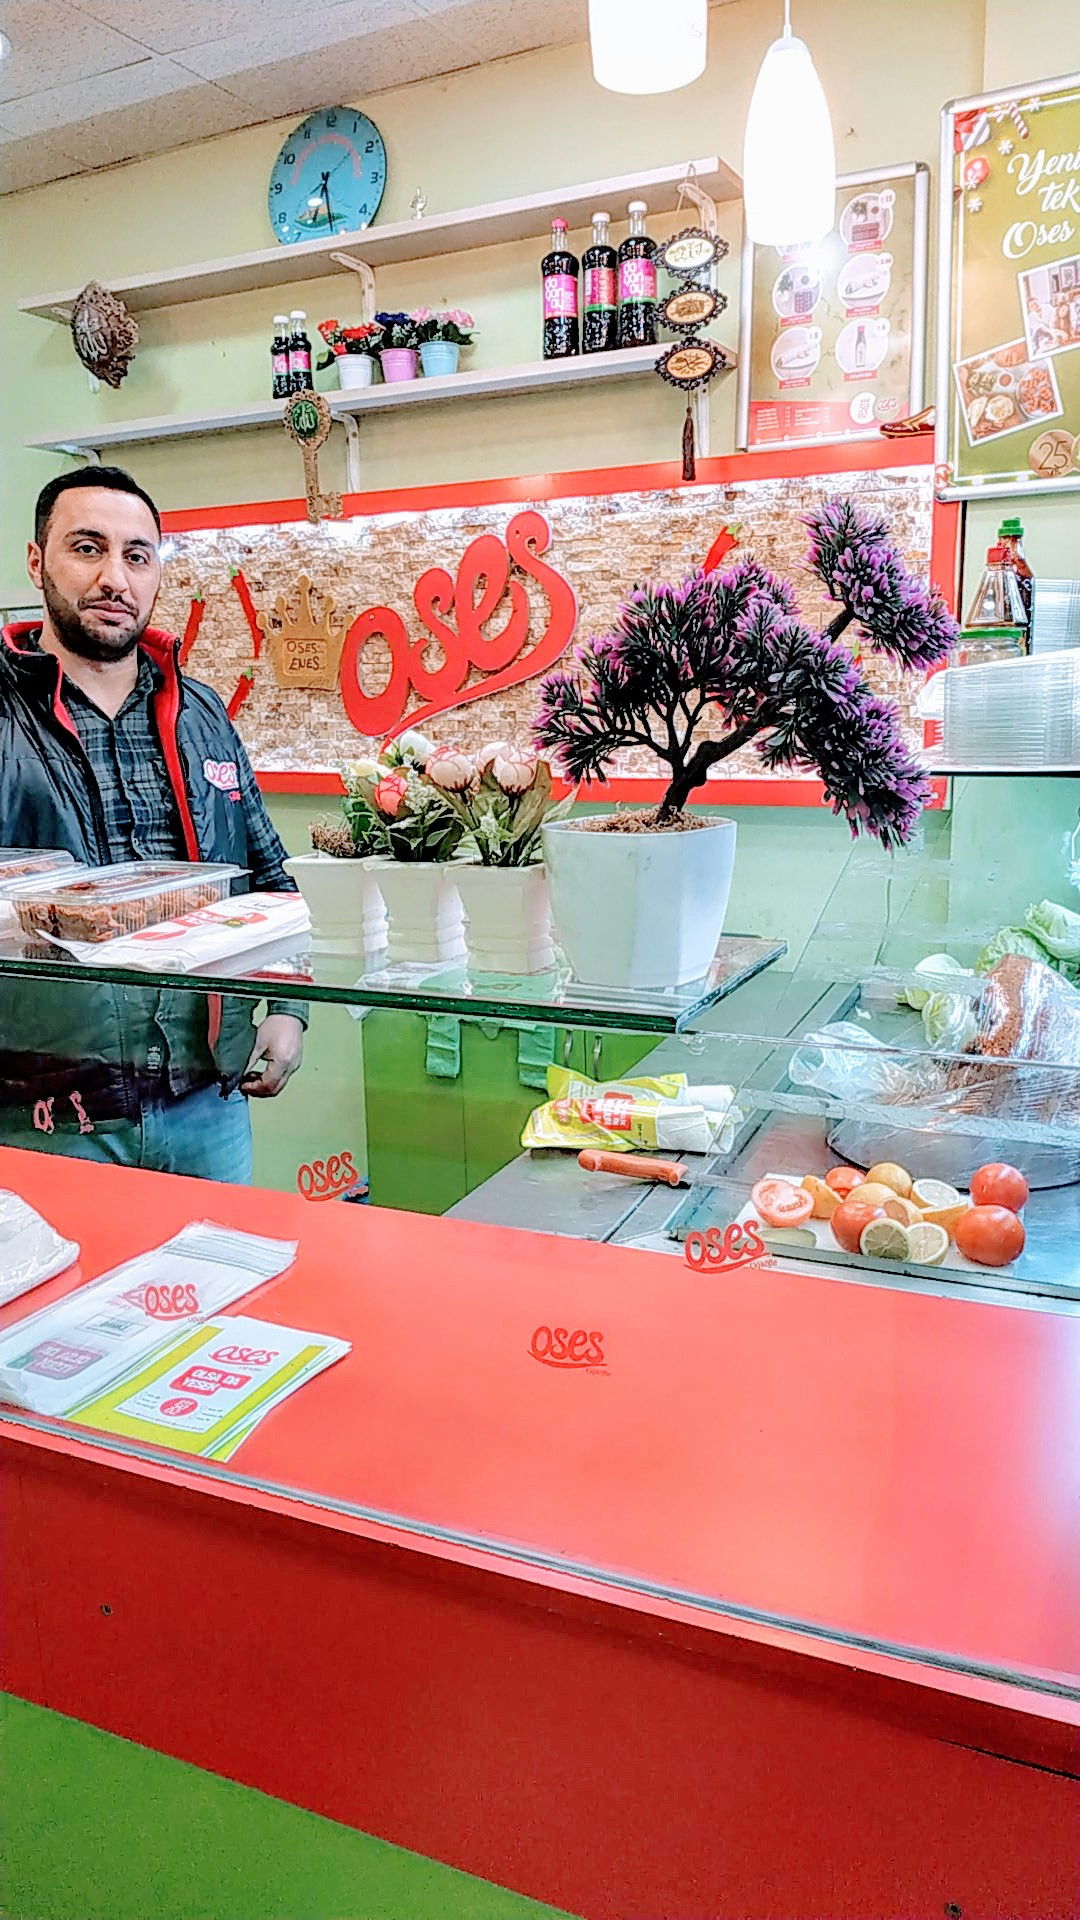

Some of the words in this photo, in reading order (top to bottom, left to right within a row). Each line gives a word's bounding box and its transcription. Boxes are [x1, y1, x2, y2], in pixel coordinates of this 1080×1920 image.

[365, 140, 374, 153] 2
[283, 152, 296, 165] 10
[371, 172, 379, 184] 3
[274, 183, 283, 195] 9
[358, 203, 369, 215] 4
[1003, 220, 1076, 259] Oses
[287, 641, 318, 654] OSES
